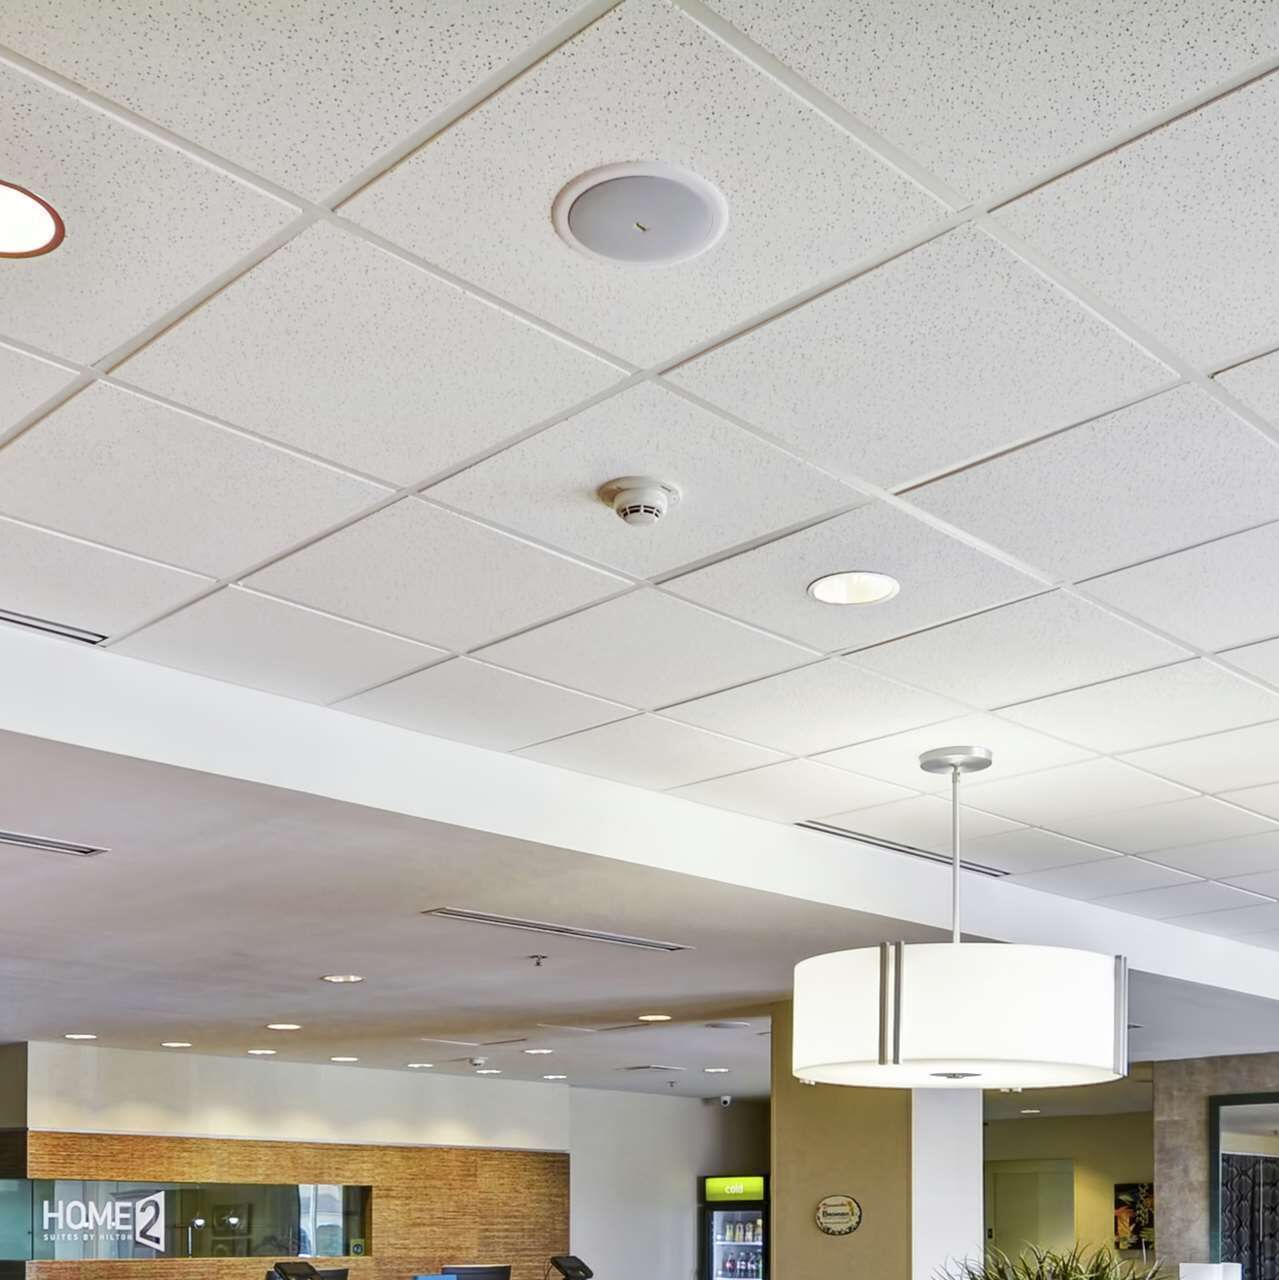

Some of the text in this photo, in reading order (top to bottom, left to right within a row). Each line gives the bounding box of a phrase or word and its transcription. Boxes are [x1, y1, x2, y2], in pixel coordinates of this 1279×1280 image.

[724, 1183, 744, 1194] cold
[43, 1233, 132, 1241] SUITES BY HILTON
